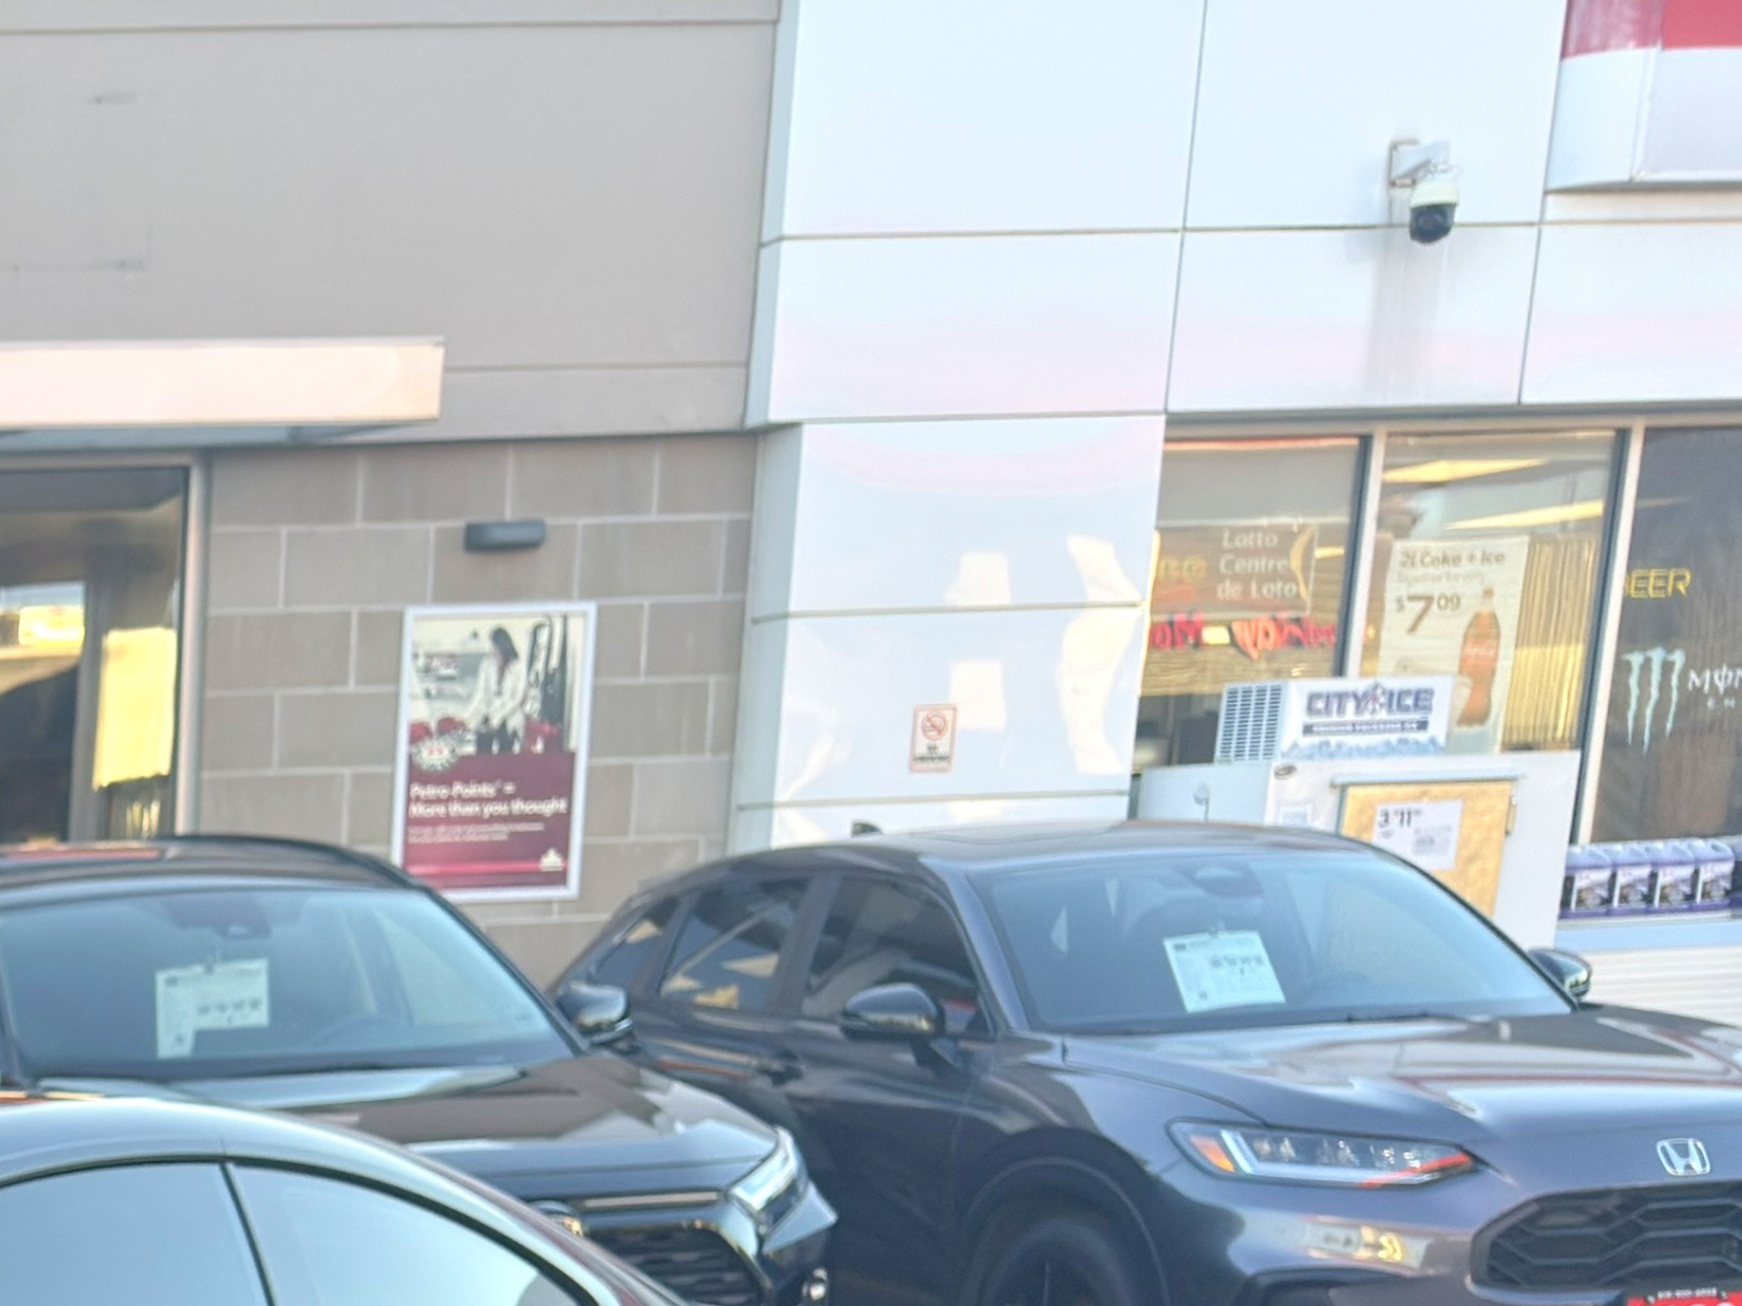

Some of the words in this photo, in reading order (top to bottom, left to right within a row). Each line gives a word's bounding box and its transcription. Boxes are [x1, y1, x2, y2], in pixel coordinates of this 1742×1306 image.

[1222, 528, 1278, 549] Lotto
[1219, 553, 1288, 575] Centre
[1217, 578, 1243, 600] de
[1251, 577, 1297, 599] Loto
[1625, 567, 1692, 599] EER
[1306, 691, 1368, 717] CITY
[1385, 688, 1435, 714] ICE
